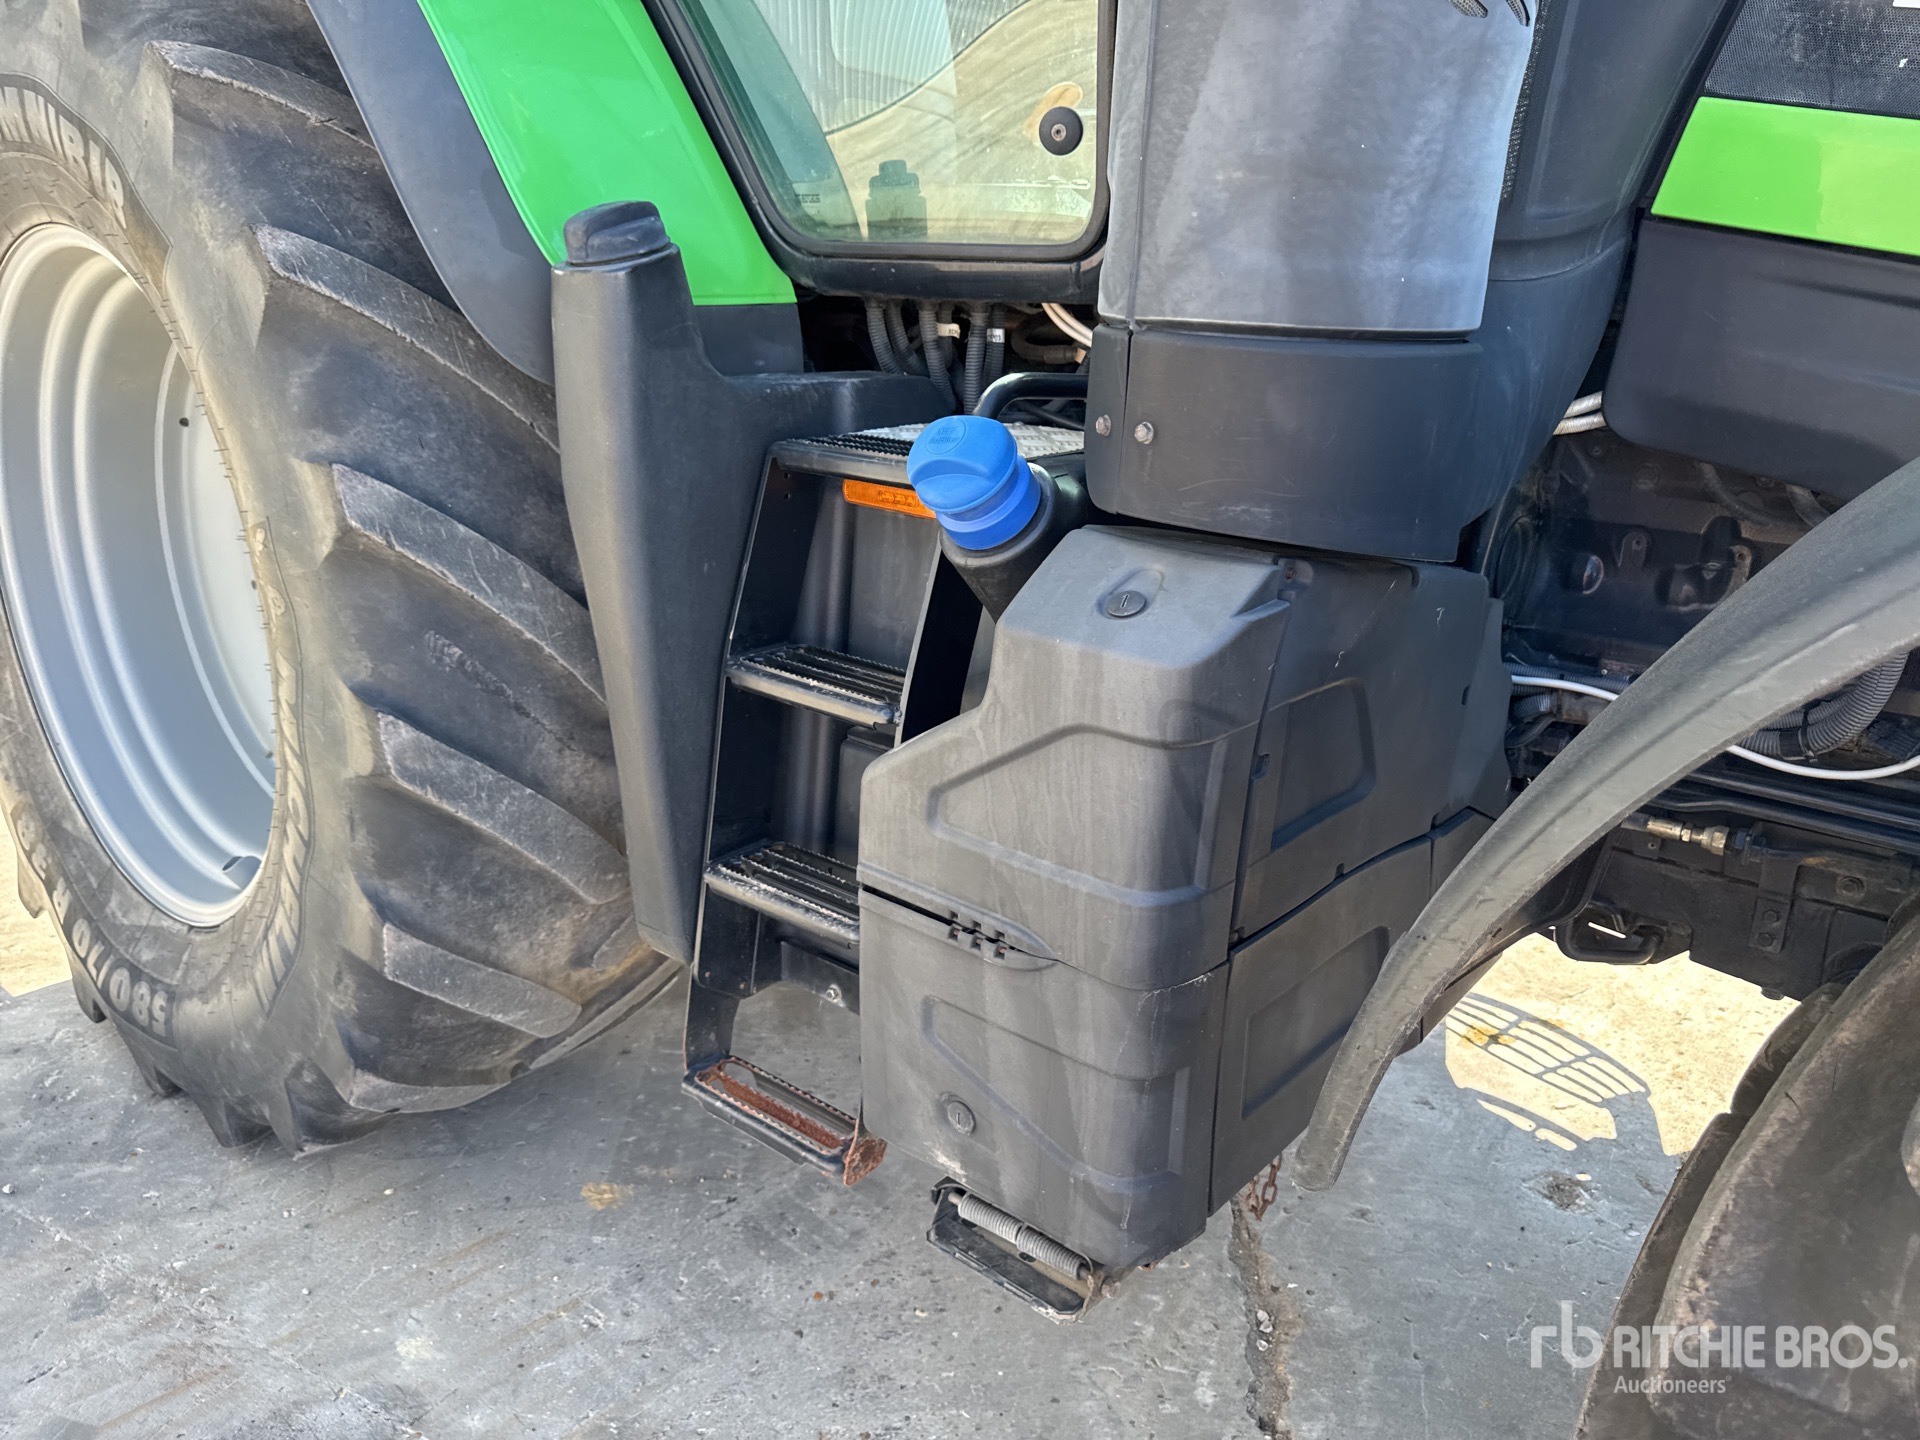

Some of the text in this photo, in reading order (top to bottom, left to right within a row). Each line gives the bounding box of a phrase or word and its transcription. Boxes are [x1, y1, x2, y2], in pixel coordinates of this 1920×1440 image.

[252, 652, 309, 1015] MICHELIN
[52, 878, 70, 922] R
[72, 917, 168, 1037] 580/70
